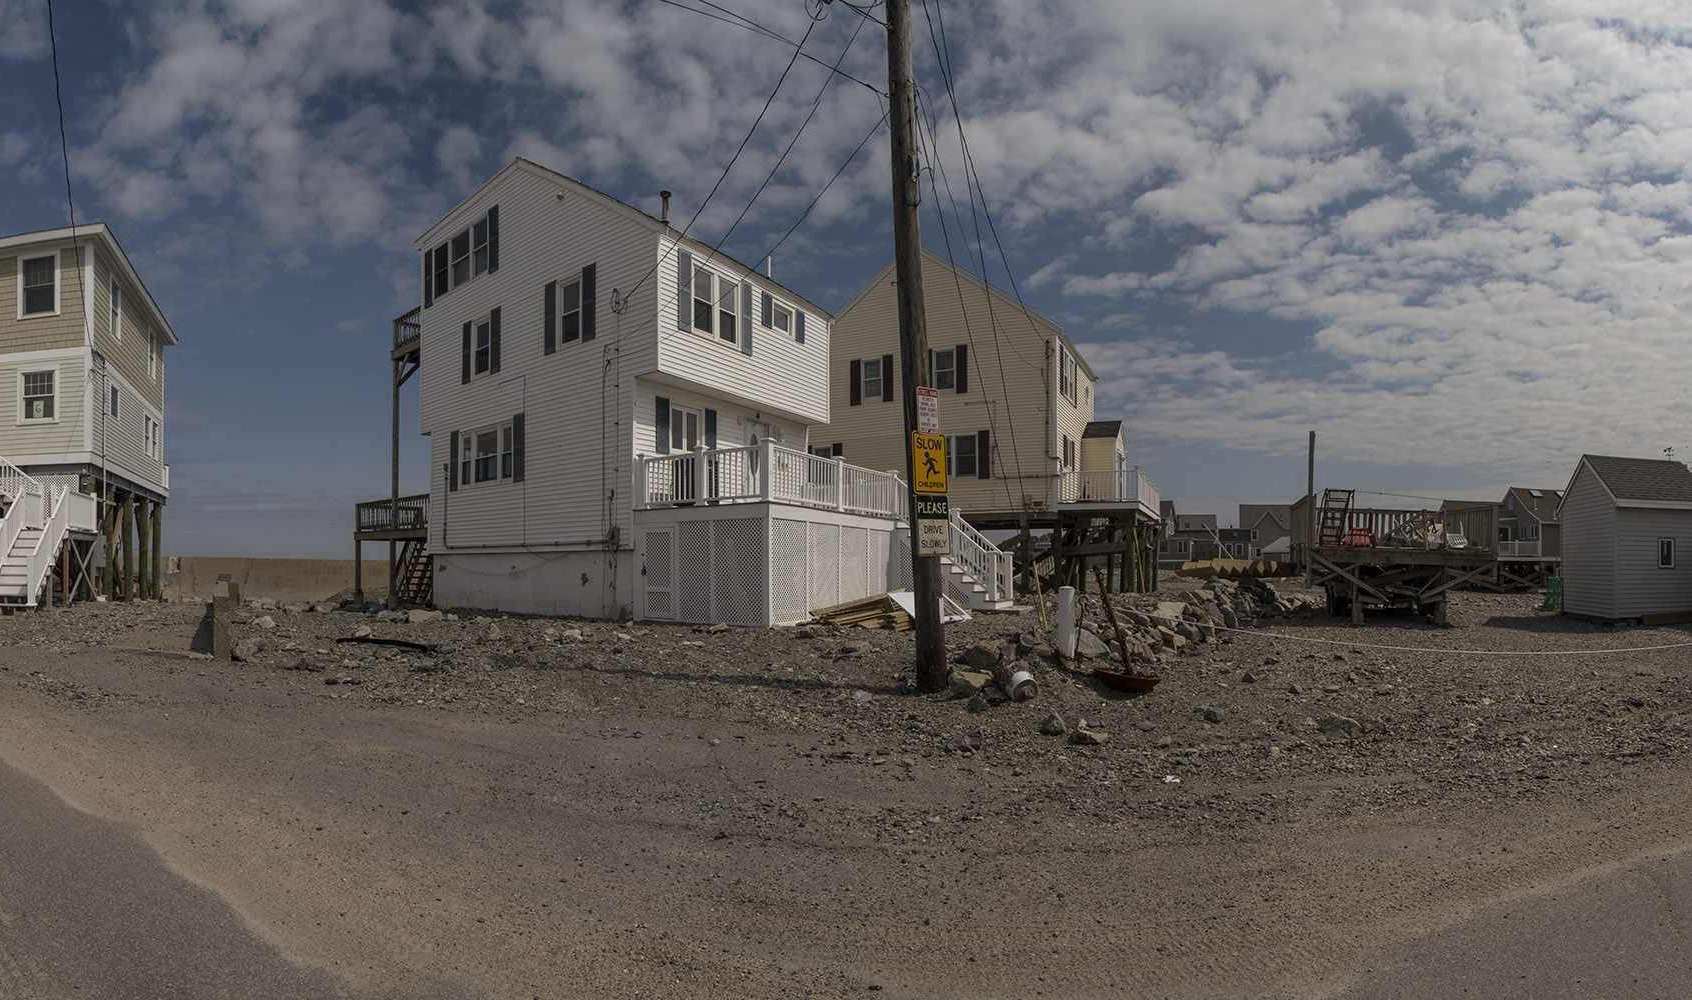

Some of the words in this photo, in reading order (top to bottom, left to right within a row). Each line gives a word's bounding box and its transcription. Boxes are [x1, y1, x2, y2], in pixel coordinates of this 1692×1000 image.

[35, 404, 41, 413] 6
[916, 437, 942, 451] SLOW
[917, 501, 947, 514] PLEASE
[923, 525, 944, 534] DRIVE
[921, 539, 947, 549] SLOWLY
